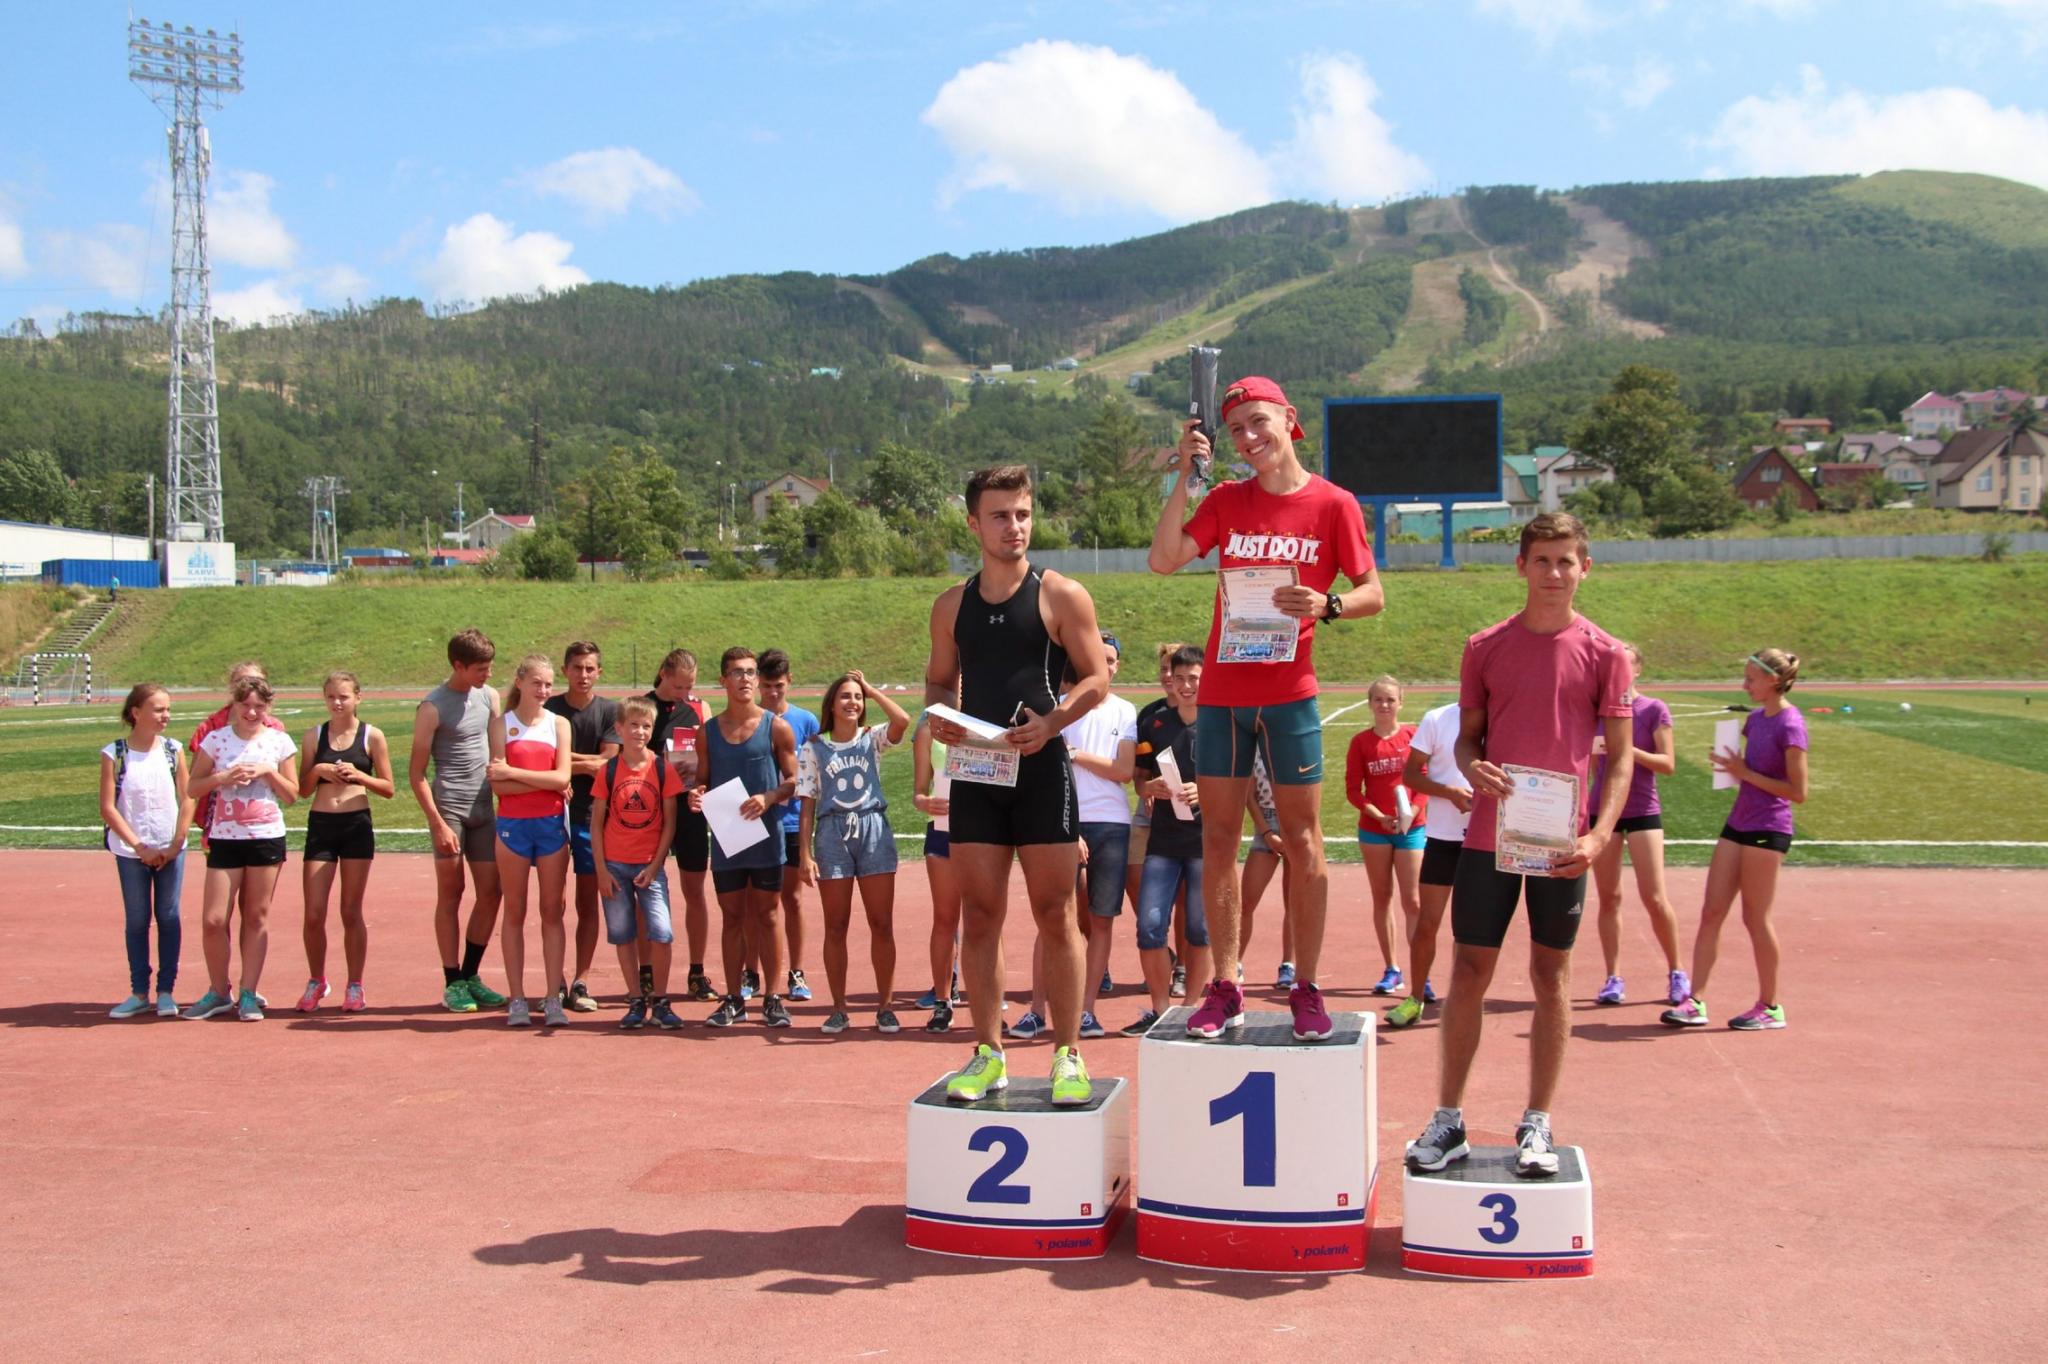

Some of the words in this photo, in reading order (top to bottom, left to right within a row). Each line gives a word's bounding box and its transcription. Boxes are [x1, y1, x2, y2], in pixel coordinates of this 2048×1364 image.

[1224, 534, 1268, 557] JUST
[1269, 536, 1298, 560] DO
[1208, 1071, 1276, 1188] 1
[967, 1125, 1031, 1204] 2
[1477, 1193, 1520, 1245] 3
[1047, 1237, 1094, 1251] polanik
[1304, 1244, 1350, 1258] polanik
[1539, 1262, 1585, 1276] polanik
